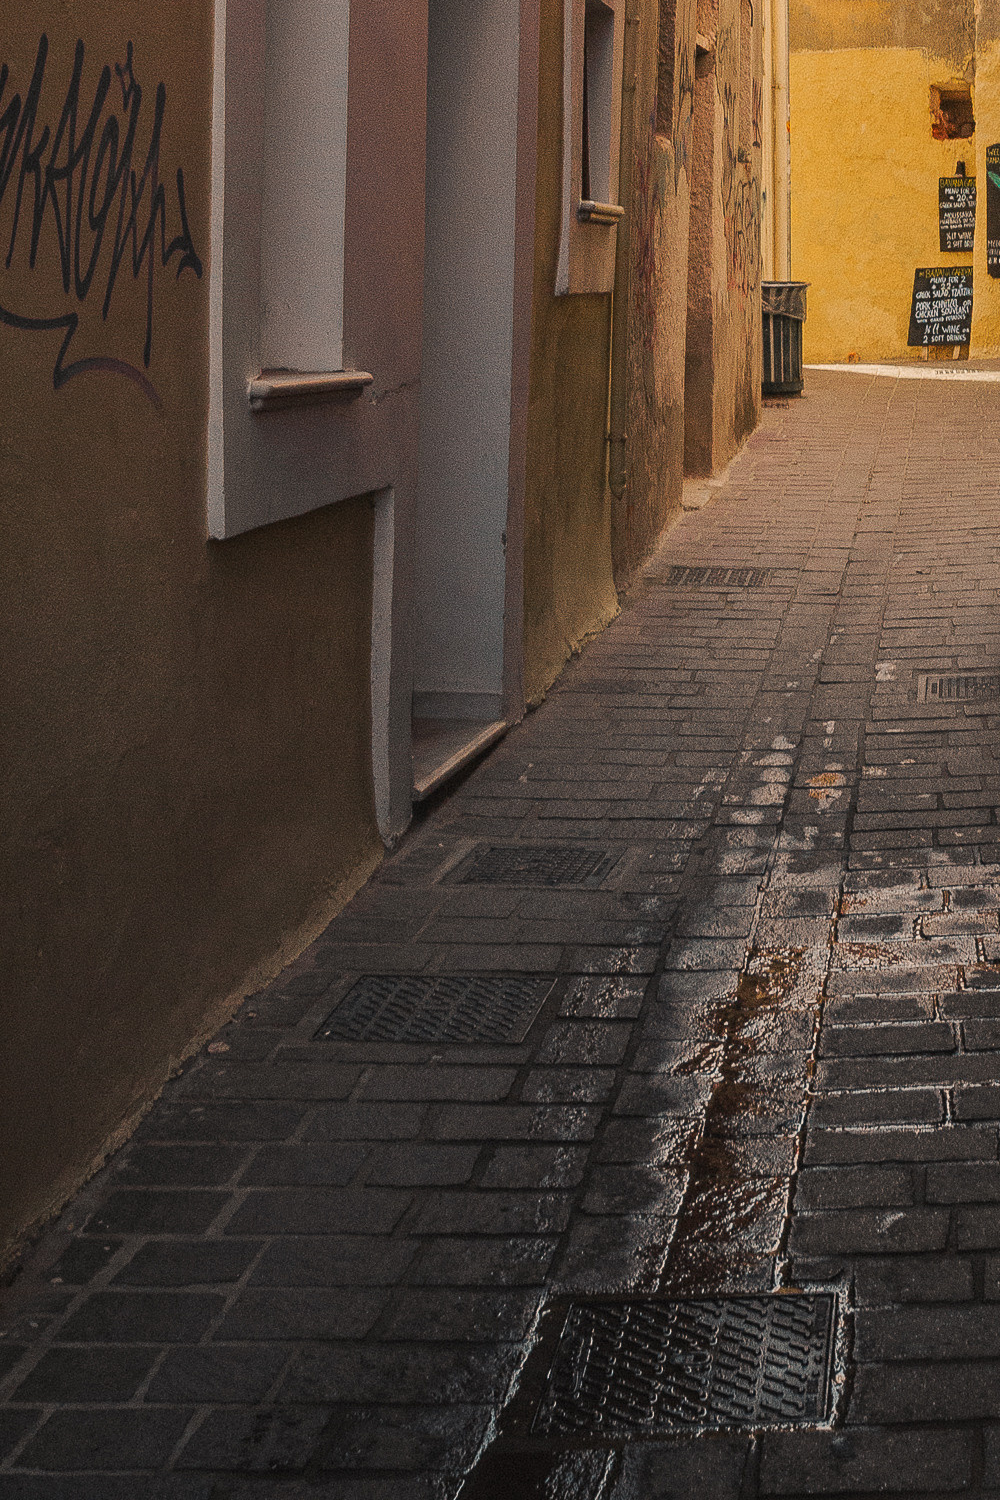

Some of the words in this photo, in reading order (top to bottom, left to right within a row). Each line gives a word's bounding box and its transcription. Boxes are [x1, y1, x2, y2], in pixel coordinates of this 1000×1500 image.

[939, 179, 963, 188] BANANA
[944, 187, 959, 195] MENU
[960, 187, 970, 195] FOR
[971, 186, 976, 194] 2
[943, 210, 973, 219] MOUSSAKA
[957, 231, 972, 240] WINE
[946, 240, 951, 249] 2
[925, 268, 951, 279] BANANA
[930, 276, 947, 284] MENU
[948, 276, 959, 284] FOR
[960, 275, 966, 283] 2
[915, 290, 931, 299] GREEK
[915, 301, 931, 311] PORK
[932, 298, 959, 310] SCHNITZEL
[914, 307, 939, 319] CHICKEN
[940, 304, 970, 316] SOUVLAKI
[941, 324, 961, 334] WINE
[922, 334, 928, 344] 2
[931, 334, 945, 343] SOFT
[946, 333, 967, 342] DRINKS
